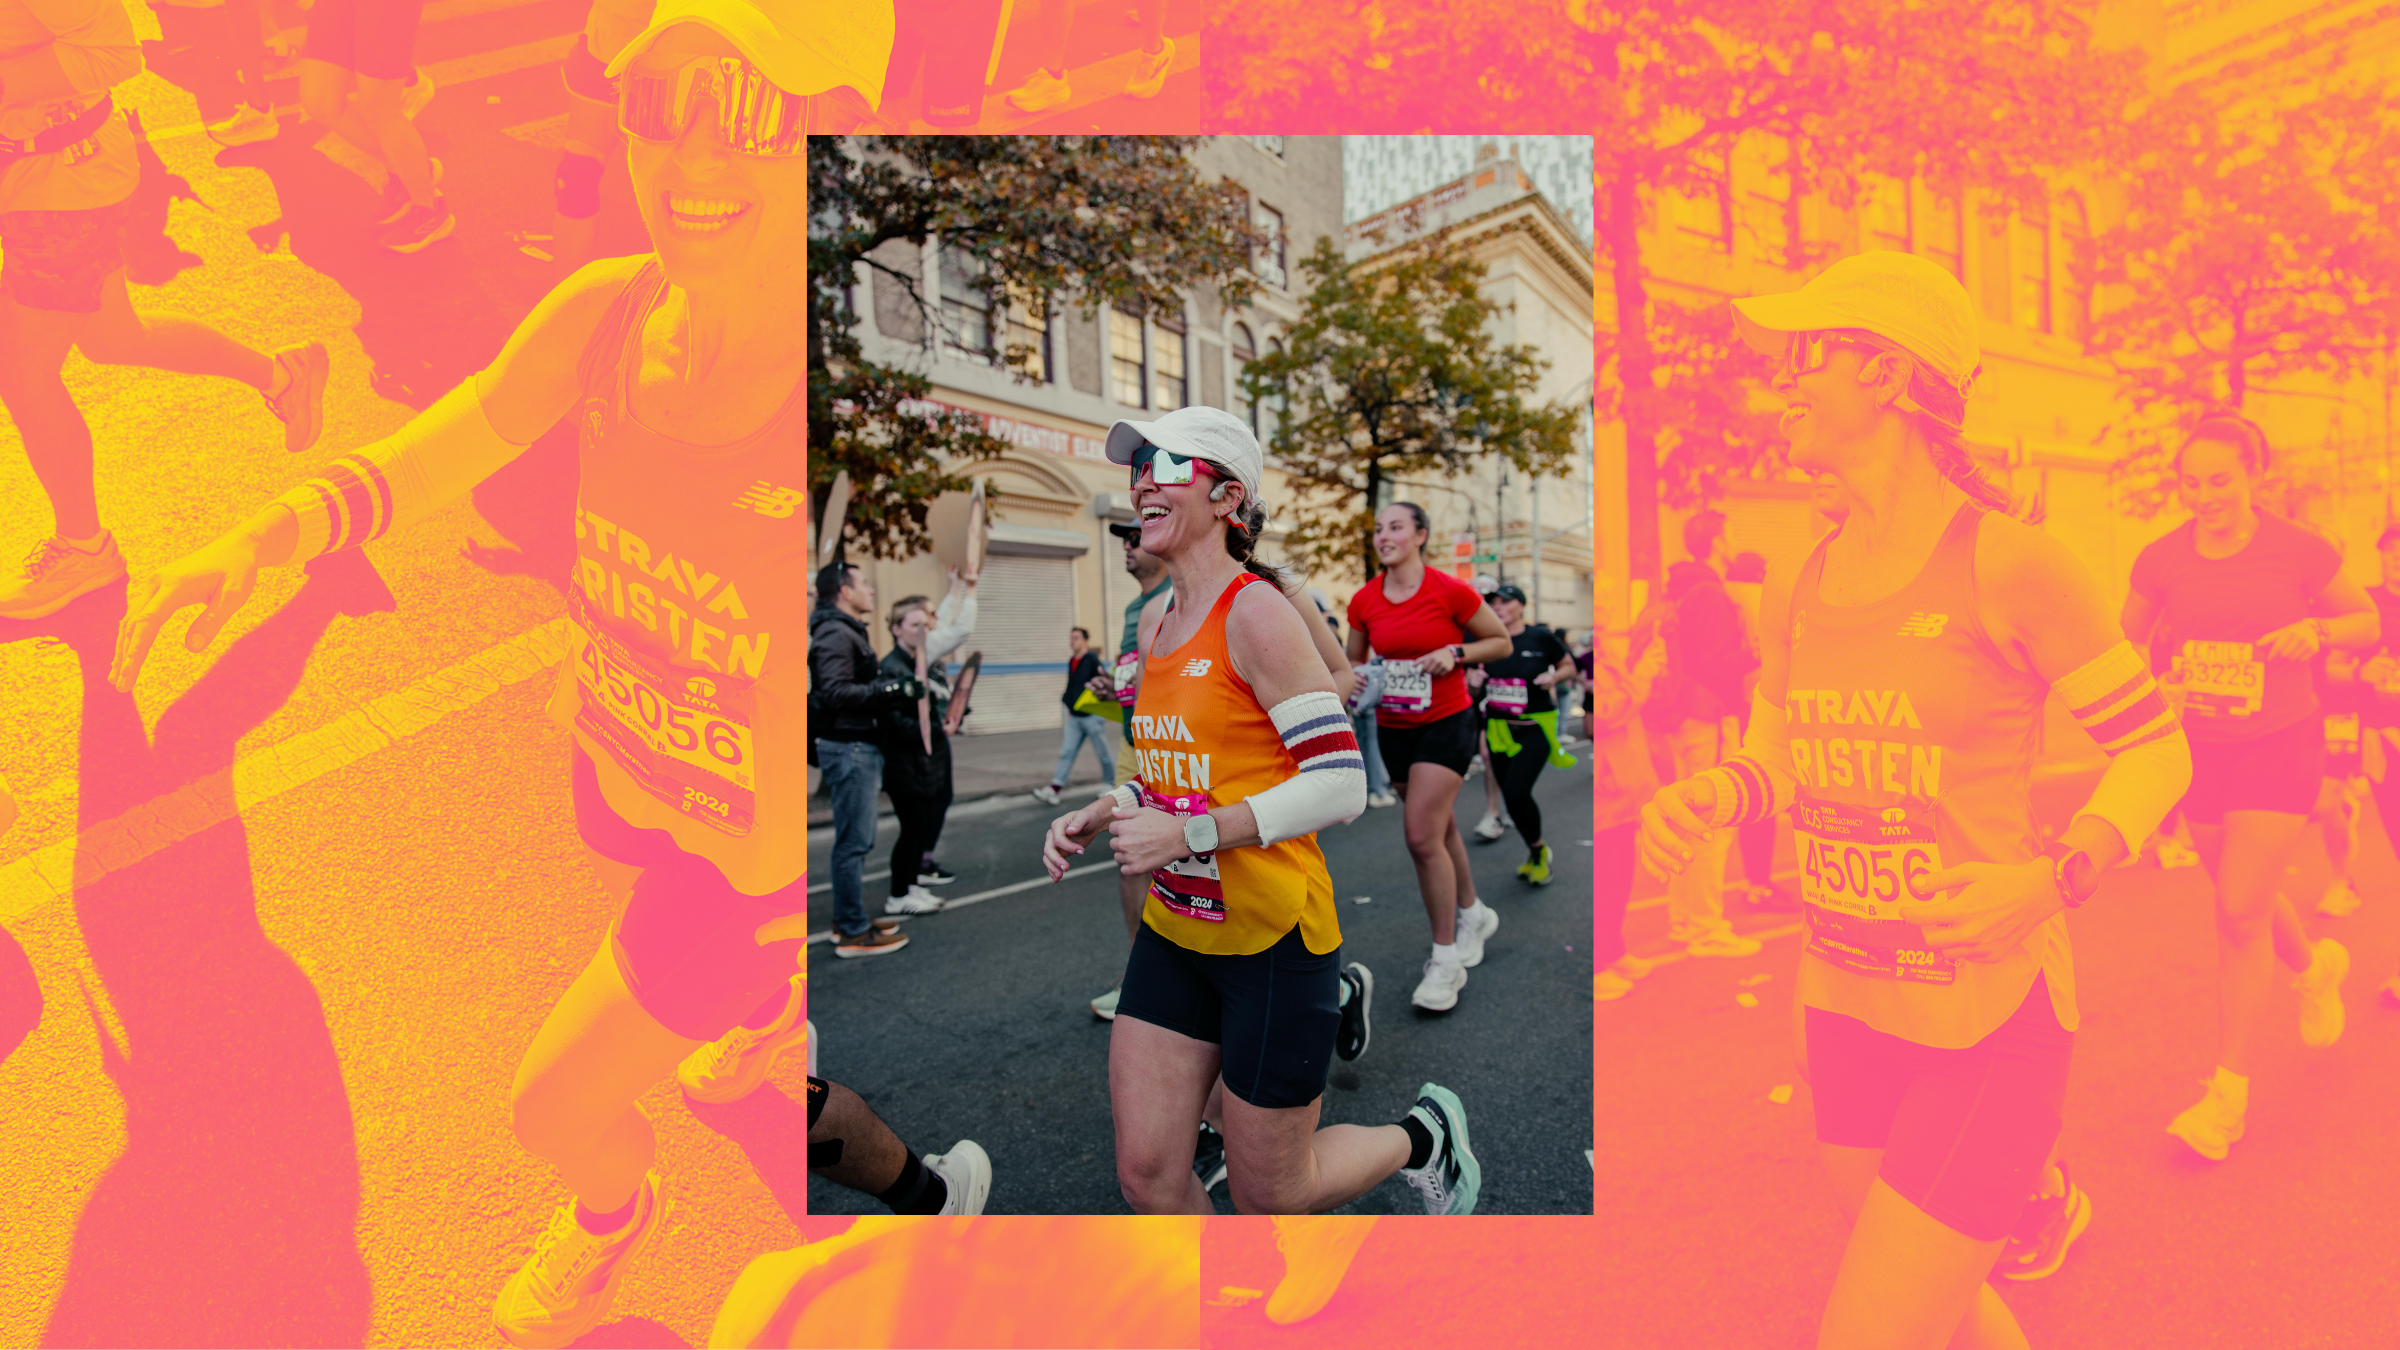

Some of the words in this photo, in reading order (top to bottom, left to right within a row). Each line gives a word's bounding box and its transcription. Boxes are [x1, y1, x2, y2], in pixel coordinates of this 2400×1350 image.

[987, 416, 1070, 454] ADVENTIST
[578, 555, 769, 678] RISTEN
[609, 637, 630, 657] TATA
[2193, 642, 2248, 662] EMILY
[611, 645, 663, 684] CONSULTANCY
[581, 640, 743, 766] 45056
[581, 671, 597, 692] WAV
[598, 691, 605, 702] 4
[608, 702, 626, 719] PINK
[627, 716, 656, 746] CORRAL
[657, 740, 667, 752] B
[682, 693, 721, 711] TATA
[1131, 715, 1195, 742] TRAVA
[1790, 738, 1941, 797] RISTEN
[681, 799, 692, 812] B
[684, 786, 730, 818] 2024
[1820, 806, 1837, 816] TATA
[1823, 816, 1863, 827] CONSULTANCY
[1824, 824, 1850, 834] SERVICES
[1879, 826, 1911, 836] TATA
[1805, 838, 1937, 903] 45056
[1190, 896, 1213, 910] 2024
[1806, 890, 1819, 901] WAV
[1820, 893, 1826, 904] 4
[1828, 897, 1843, 908] PINK
[1844, 901, 1867, 913] CORRAL
[1868, 905, 1877, 916] B
[1896, 949, 1935, 966] 2024
[1896, 966, 1905, 977] B
